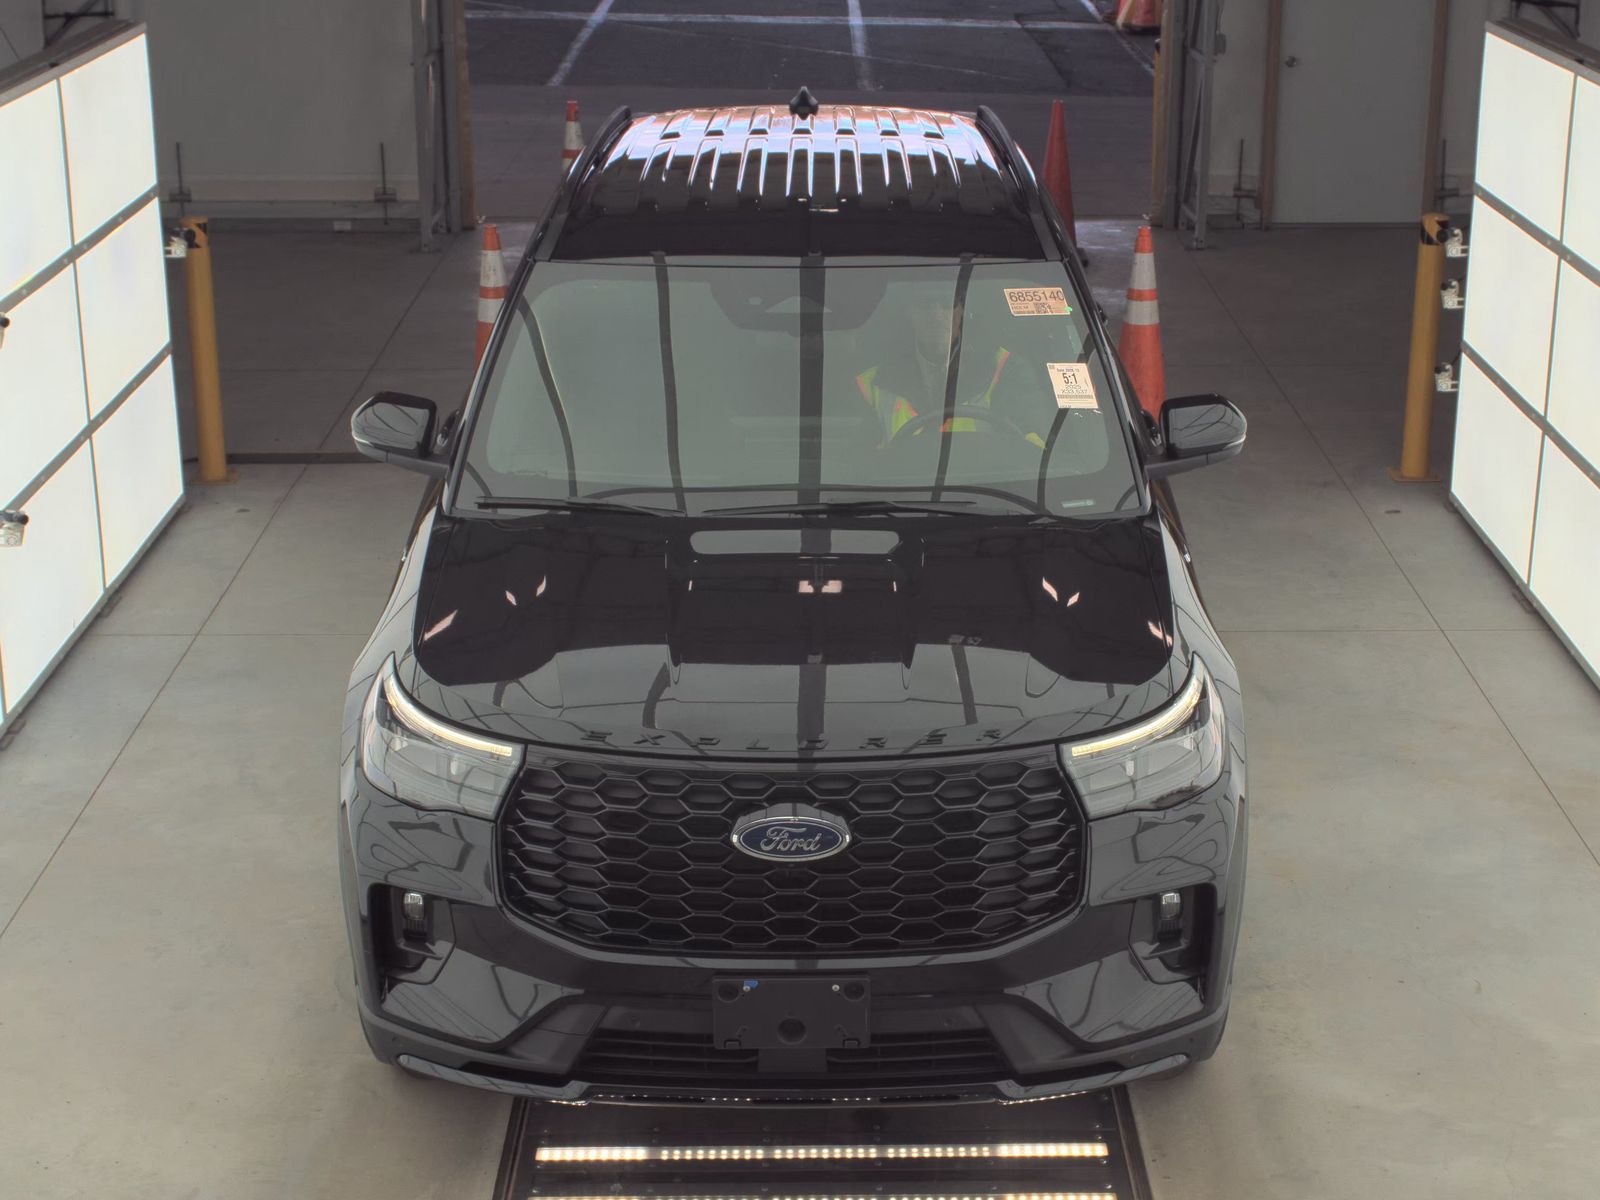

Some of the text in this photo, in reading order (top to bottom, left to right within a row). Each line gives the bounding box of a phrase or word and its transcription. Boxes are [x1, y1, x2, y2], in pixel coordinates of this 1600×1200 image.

[1009, 290, 1065, 302] 6855140
[1062, 372, 1078, 384] 5:1
[760, 825, 822, 852] Ford
